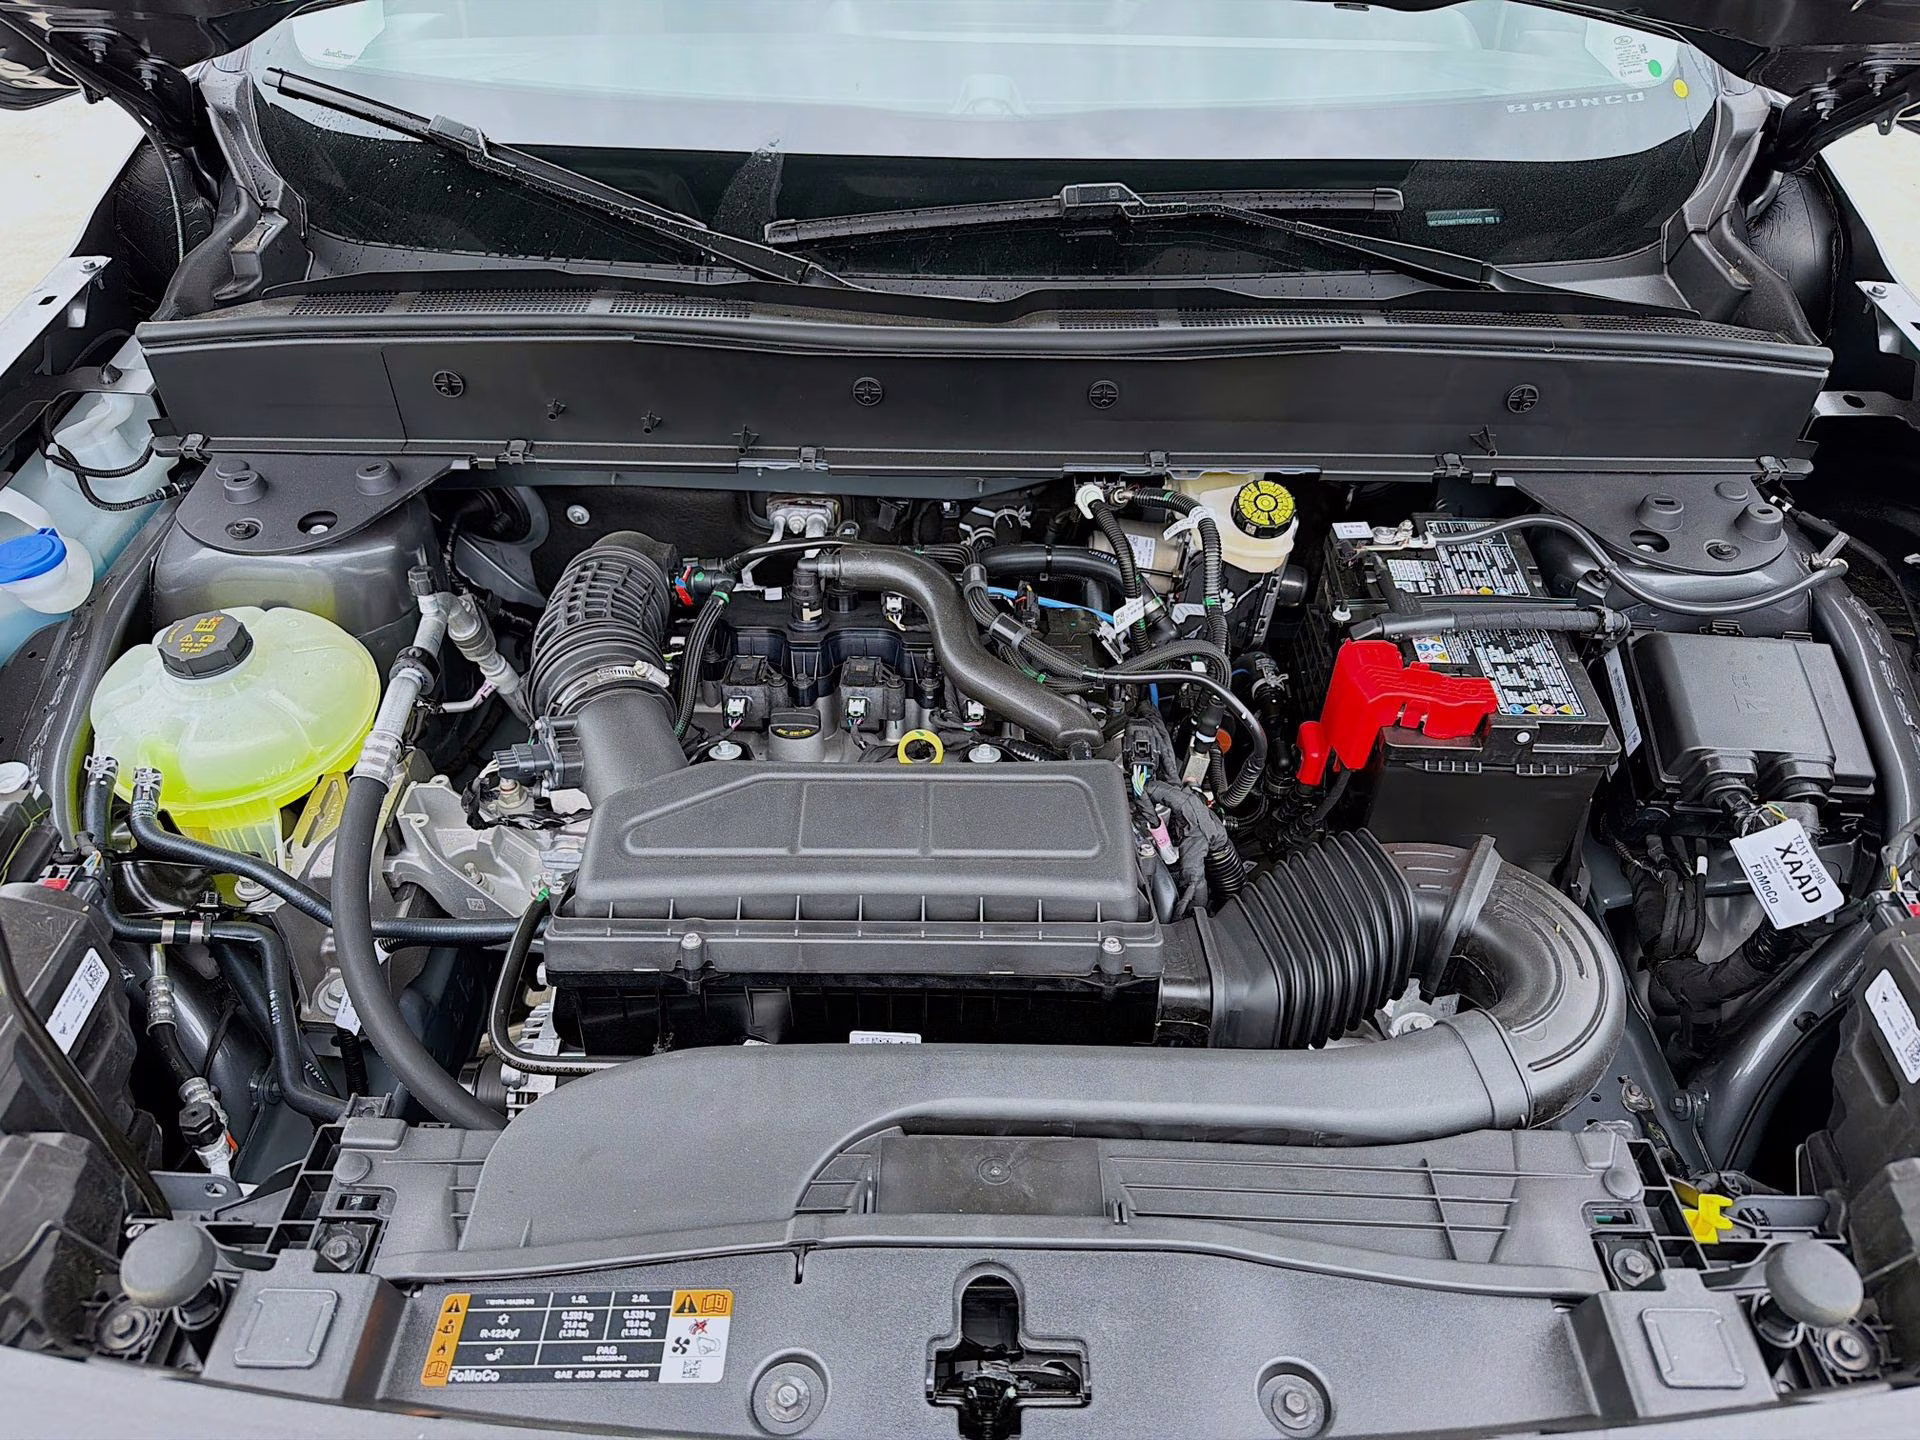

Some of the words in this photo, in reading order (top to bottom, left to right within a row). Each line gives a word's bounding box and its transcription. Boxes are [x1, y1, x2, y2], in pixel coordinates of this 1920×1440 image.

[1506, 92, 1645, 113] BRONCO
[1775, 842, 1822, 904] XAAD
[1806, 858, 1827, 885] 14290
[1750, 863, 1779, 904] FoMoCo
[631, 1294, 650, 1303] 2.0L
[583, 1311, 594, 1321] kg
[645, 1310, 656, 1320] kg
[479, 1328, 521, 1340] R-1234yf
[596, 1346, 618, 1355] PAG
[447, 1369, 500, 1382] FoMoCo
[554, 1370, 573, 1379] SAE
